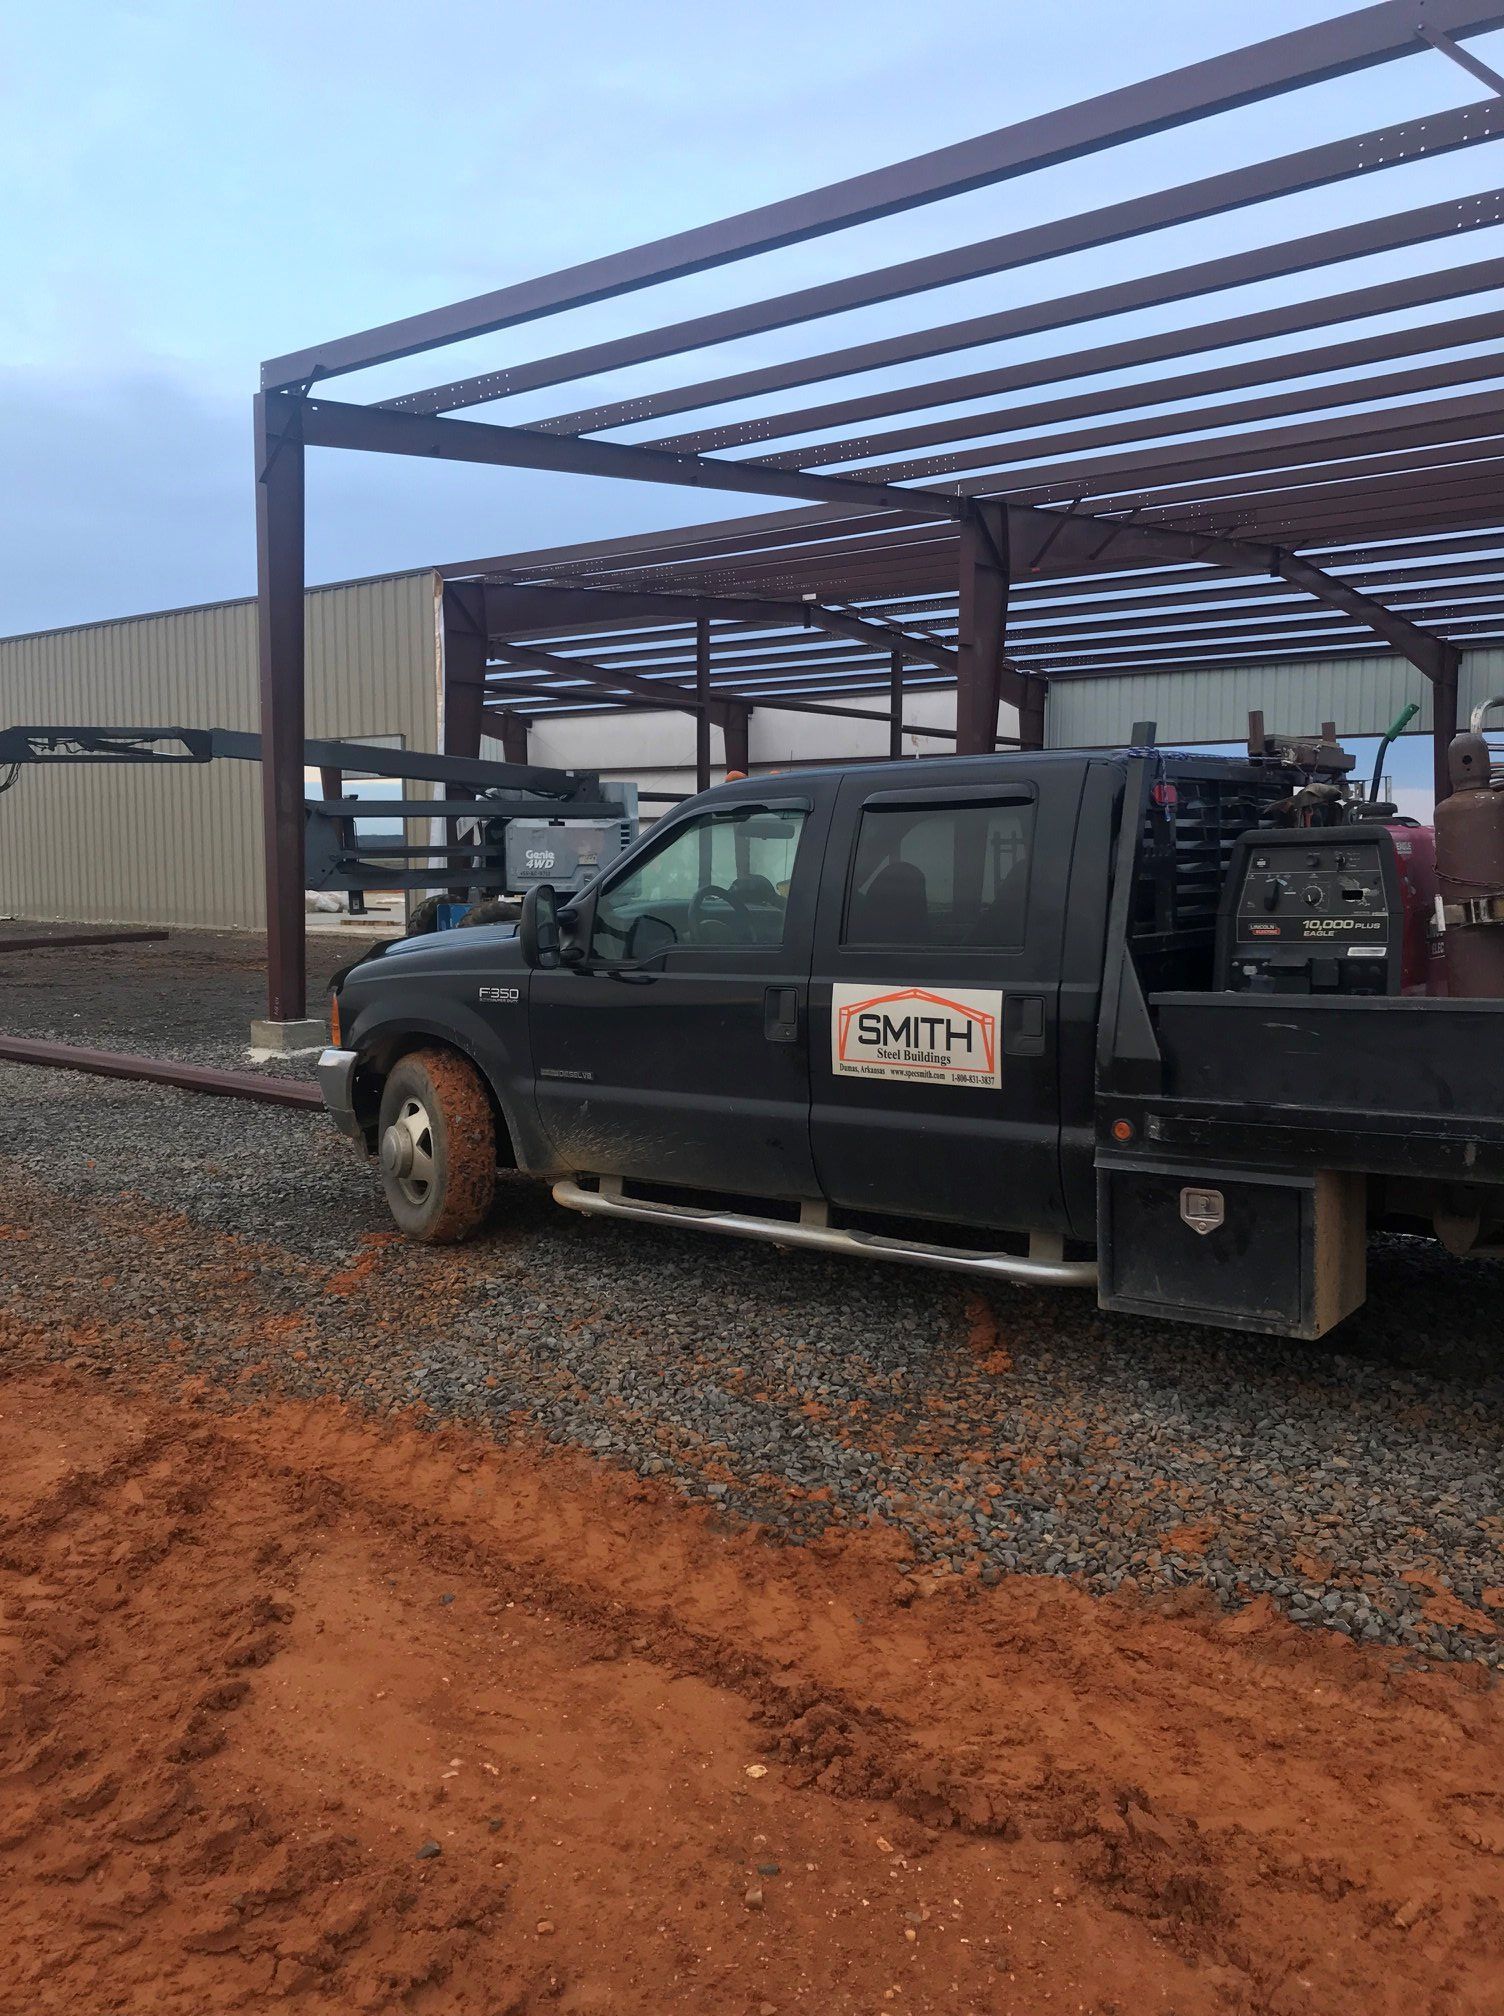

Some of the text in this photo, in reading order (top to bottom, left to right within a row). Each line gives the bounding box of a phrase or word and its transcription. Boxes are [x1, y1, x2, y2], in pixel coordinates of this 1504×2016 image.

[525, 849, 555, 859] Genie
[525, 859, 554, 868] 4WD
[1302, 920, 1355, 930] 10,000
[858, 1014, 972, 1053] SMITH
[877, 1048, 952, 1066] Steel Buildings
[839, 1063, 860, 1074] Dumas,
[861, 1065, 886, 1075] Arkansas
[890, 1068, 946, 1080] www.specsmith.com
